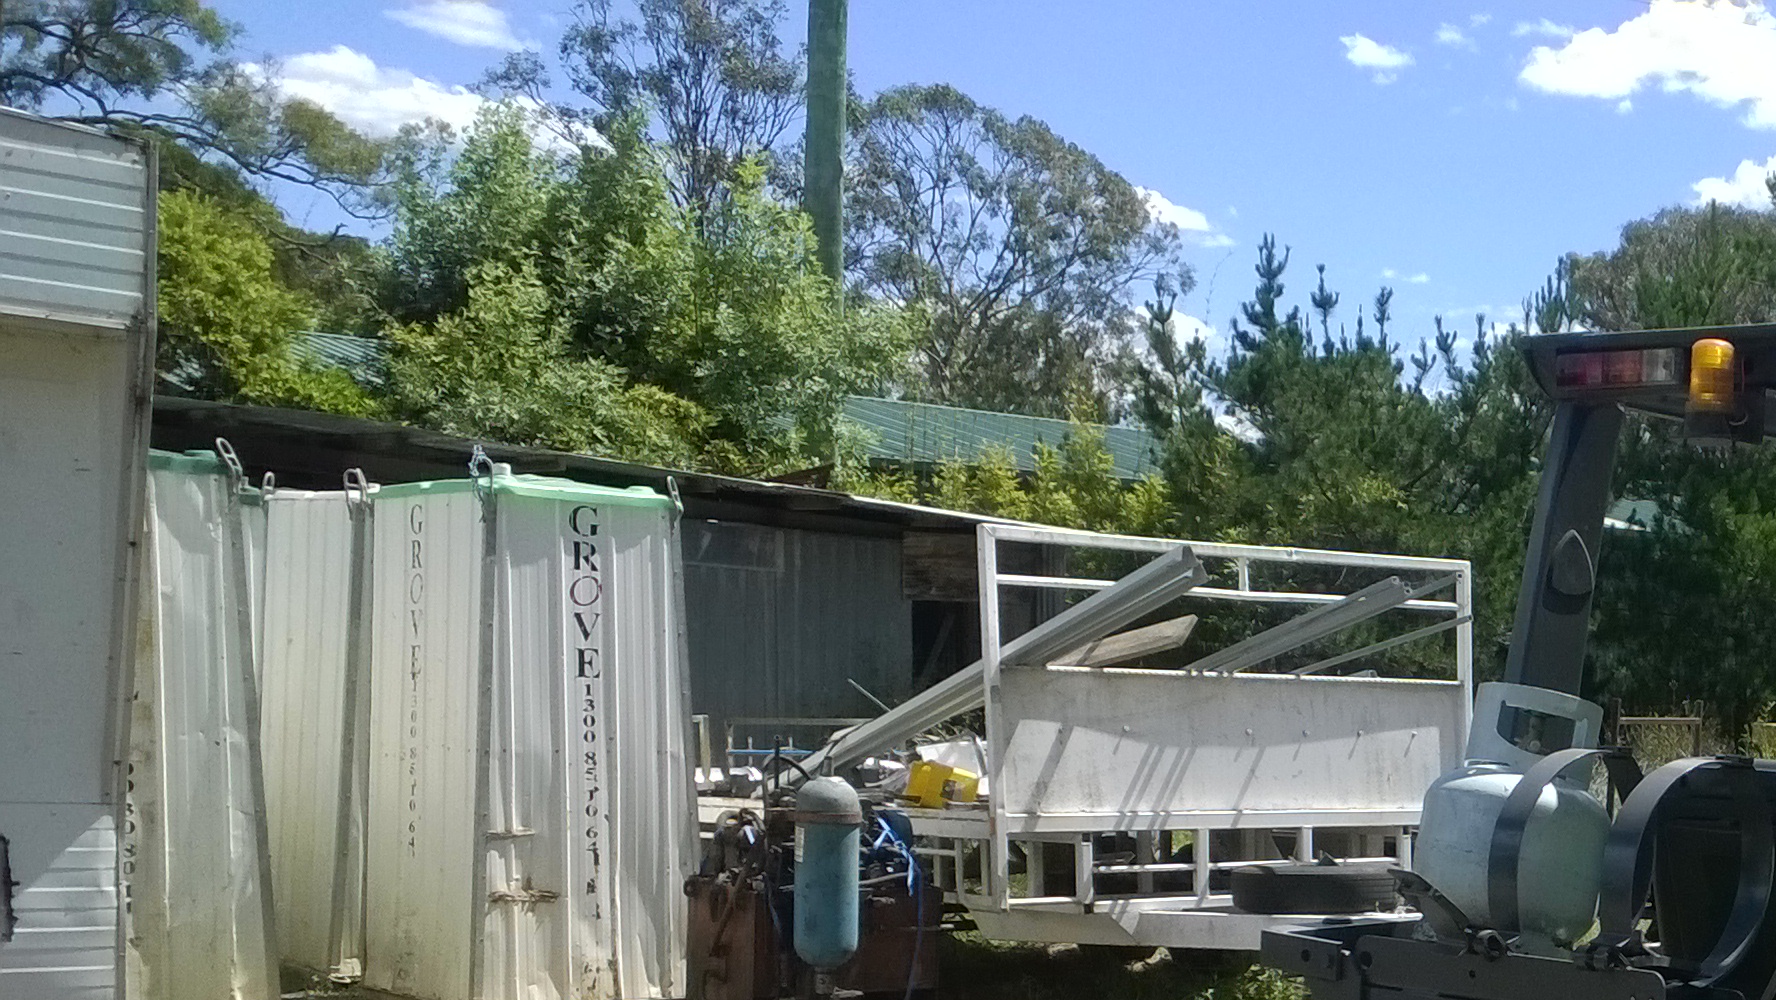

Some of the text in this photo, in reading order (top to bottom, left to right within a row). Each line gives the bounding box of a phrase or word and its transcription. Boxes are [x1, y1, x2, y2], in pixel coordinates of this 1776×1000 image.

[409, 503, 424, 675] GROVE
[568, 505, 602, 679] GROVE
[582, 684, 597, 743] 1300
